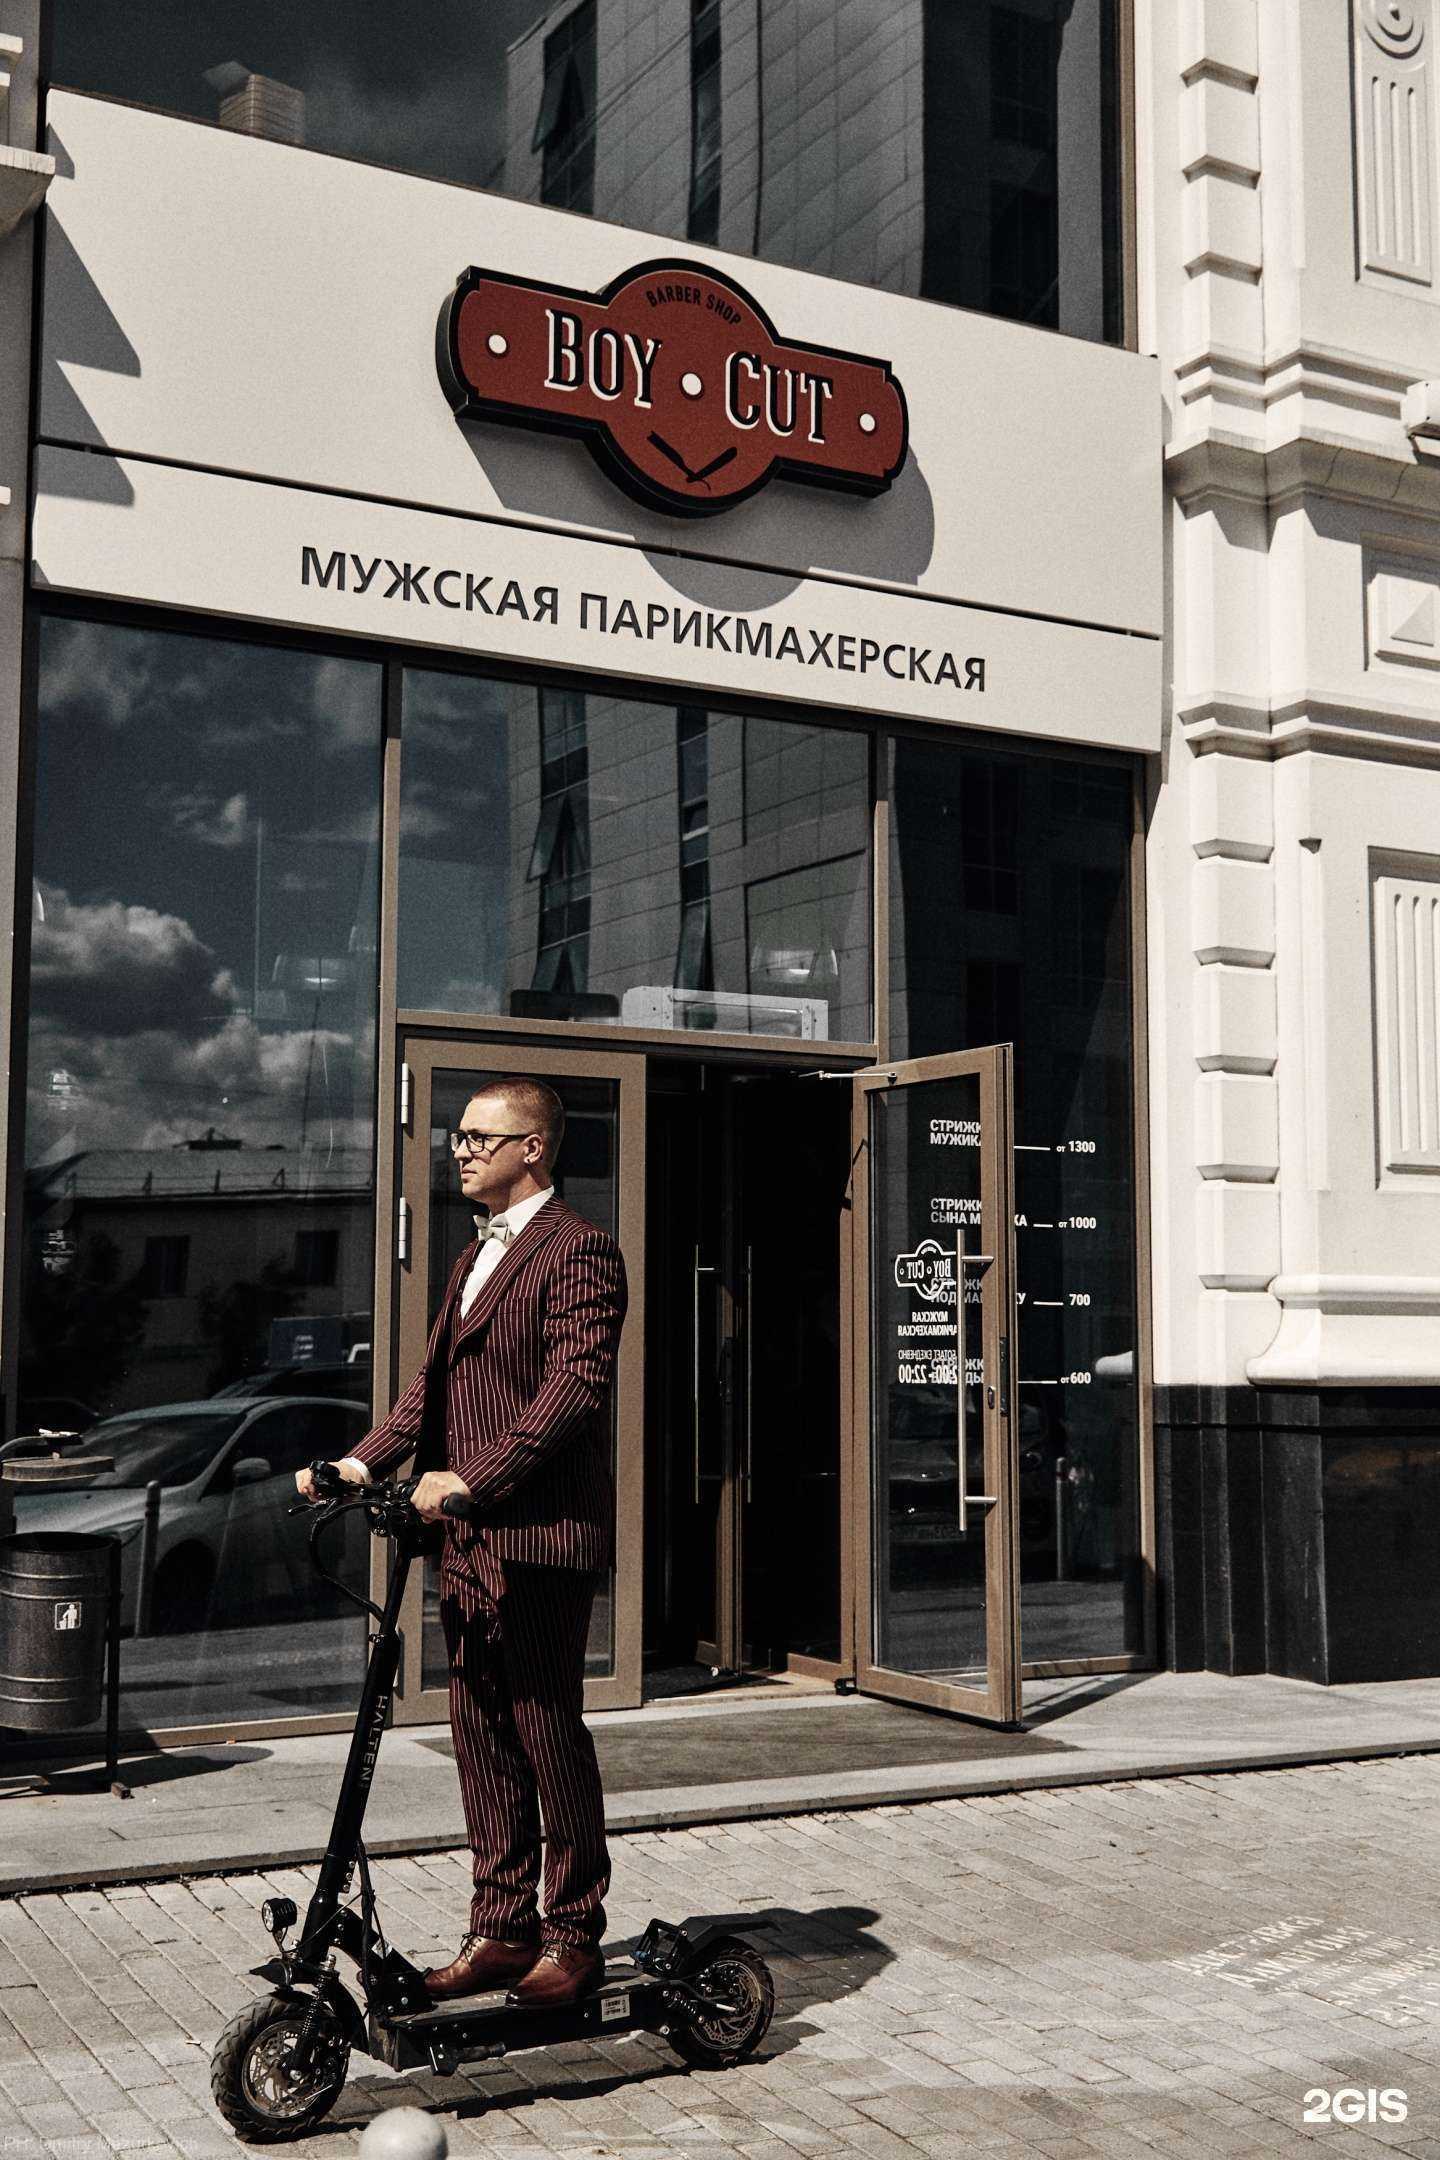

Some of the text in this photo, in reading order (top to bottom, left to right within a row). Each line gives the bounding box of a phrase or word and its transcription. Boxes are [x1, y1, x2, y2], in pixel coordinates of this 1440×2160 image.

[646, 284, 742, 326] BARBER SHOP
[544, 308, 833, 444] BOY CUT
[301, 545, 986, 693] МУЖСКАЯ ПАРИКМАХЕРСКАЯ
[930, 1119, 982, 1133] СТРИЖК
[930, 1133, 982, 1147] МУЖИК
[1068, 1140, 1096, 1153] 1300
[930, 1198, 982, 1211] СТРИЖК
[930, 1211, 967, 1224] СЫНА
[1069, 1216, 1097, 1229] 1000
[1069, 1293, 1091, 1306] 700
[1060, 1371, 1091, 1384] от 600
